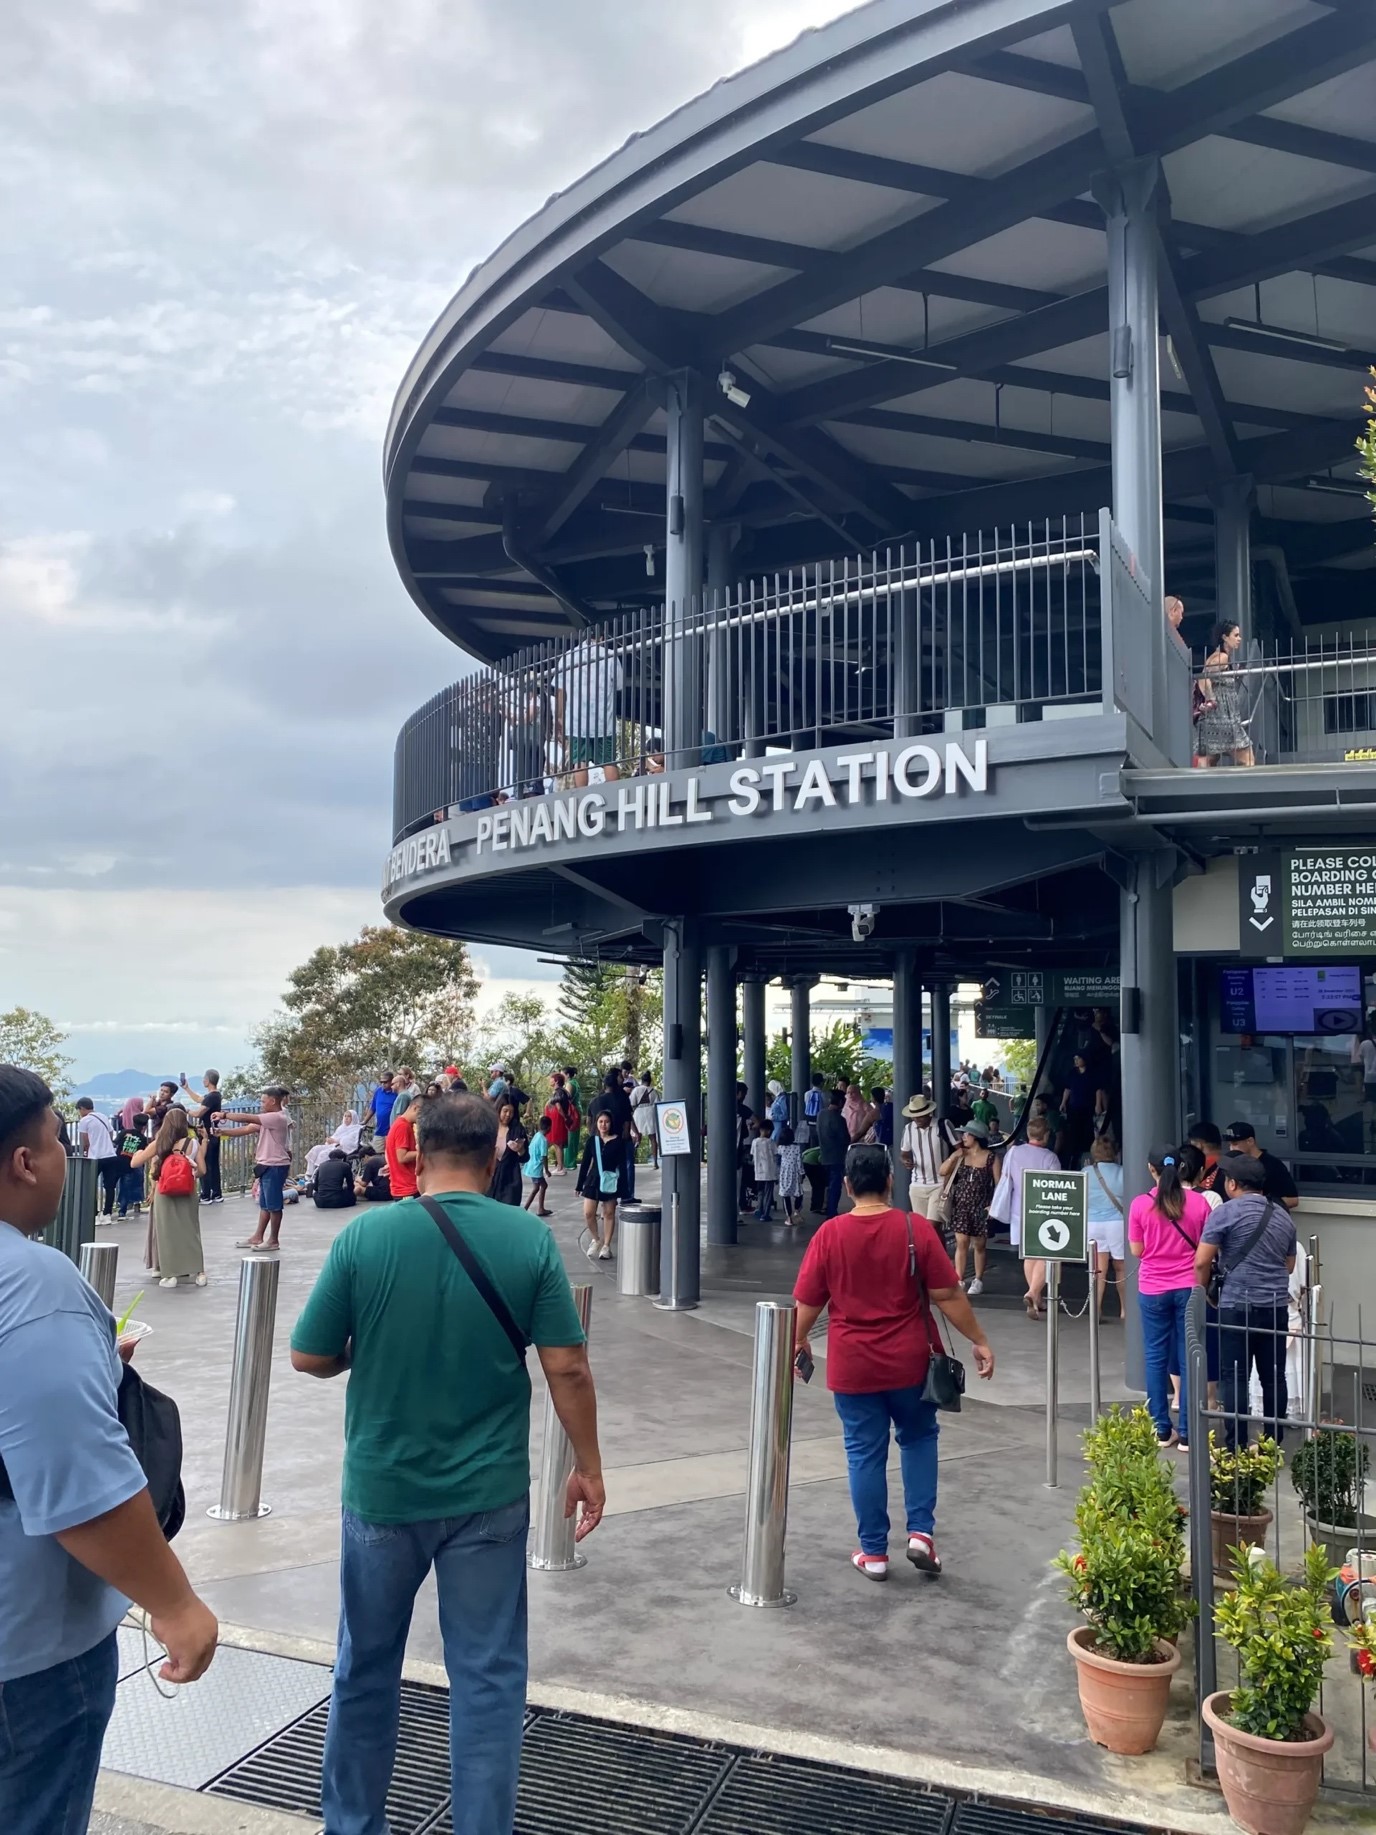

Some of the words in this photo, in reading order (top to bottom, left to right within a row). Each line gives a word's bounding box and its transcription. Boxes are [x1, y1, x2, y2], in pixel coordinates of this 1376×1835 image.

[391, 828, 451, 883] BENDERA
[477, 793, 606, 854] PENANG
[618, 777, 713, 831] HILL
[728, 739, 988, 816] STATION
[1291, 857, 1343, 870] PLEASE
[1291, 869, 1368, 883] BOARDING
[1291, 883, 1352, 896] NUMBER
[1291, 899, 1314, 908] SILA
[1315, 898, 1347, 907] AMBIL
[1291, 907, 1346, 917] PELEPASAN
[1348, 907, 1358, 915] DI
[1063, 976, 1102, 985] WAITING
[1230, 987, 1245, 996] U2
[1032, 1179, 1077, 1190] NORMAL
[1041, 1191, 1068, 1201] LANE
